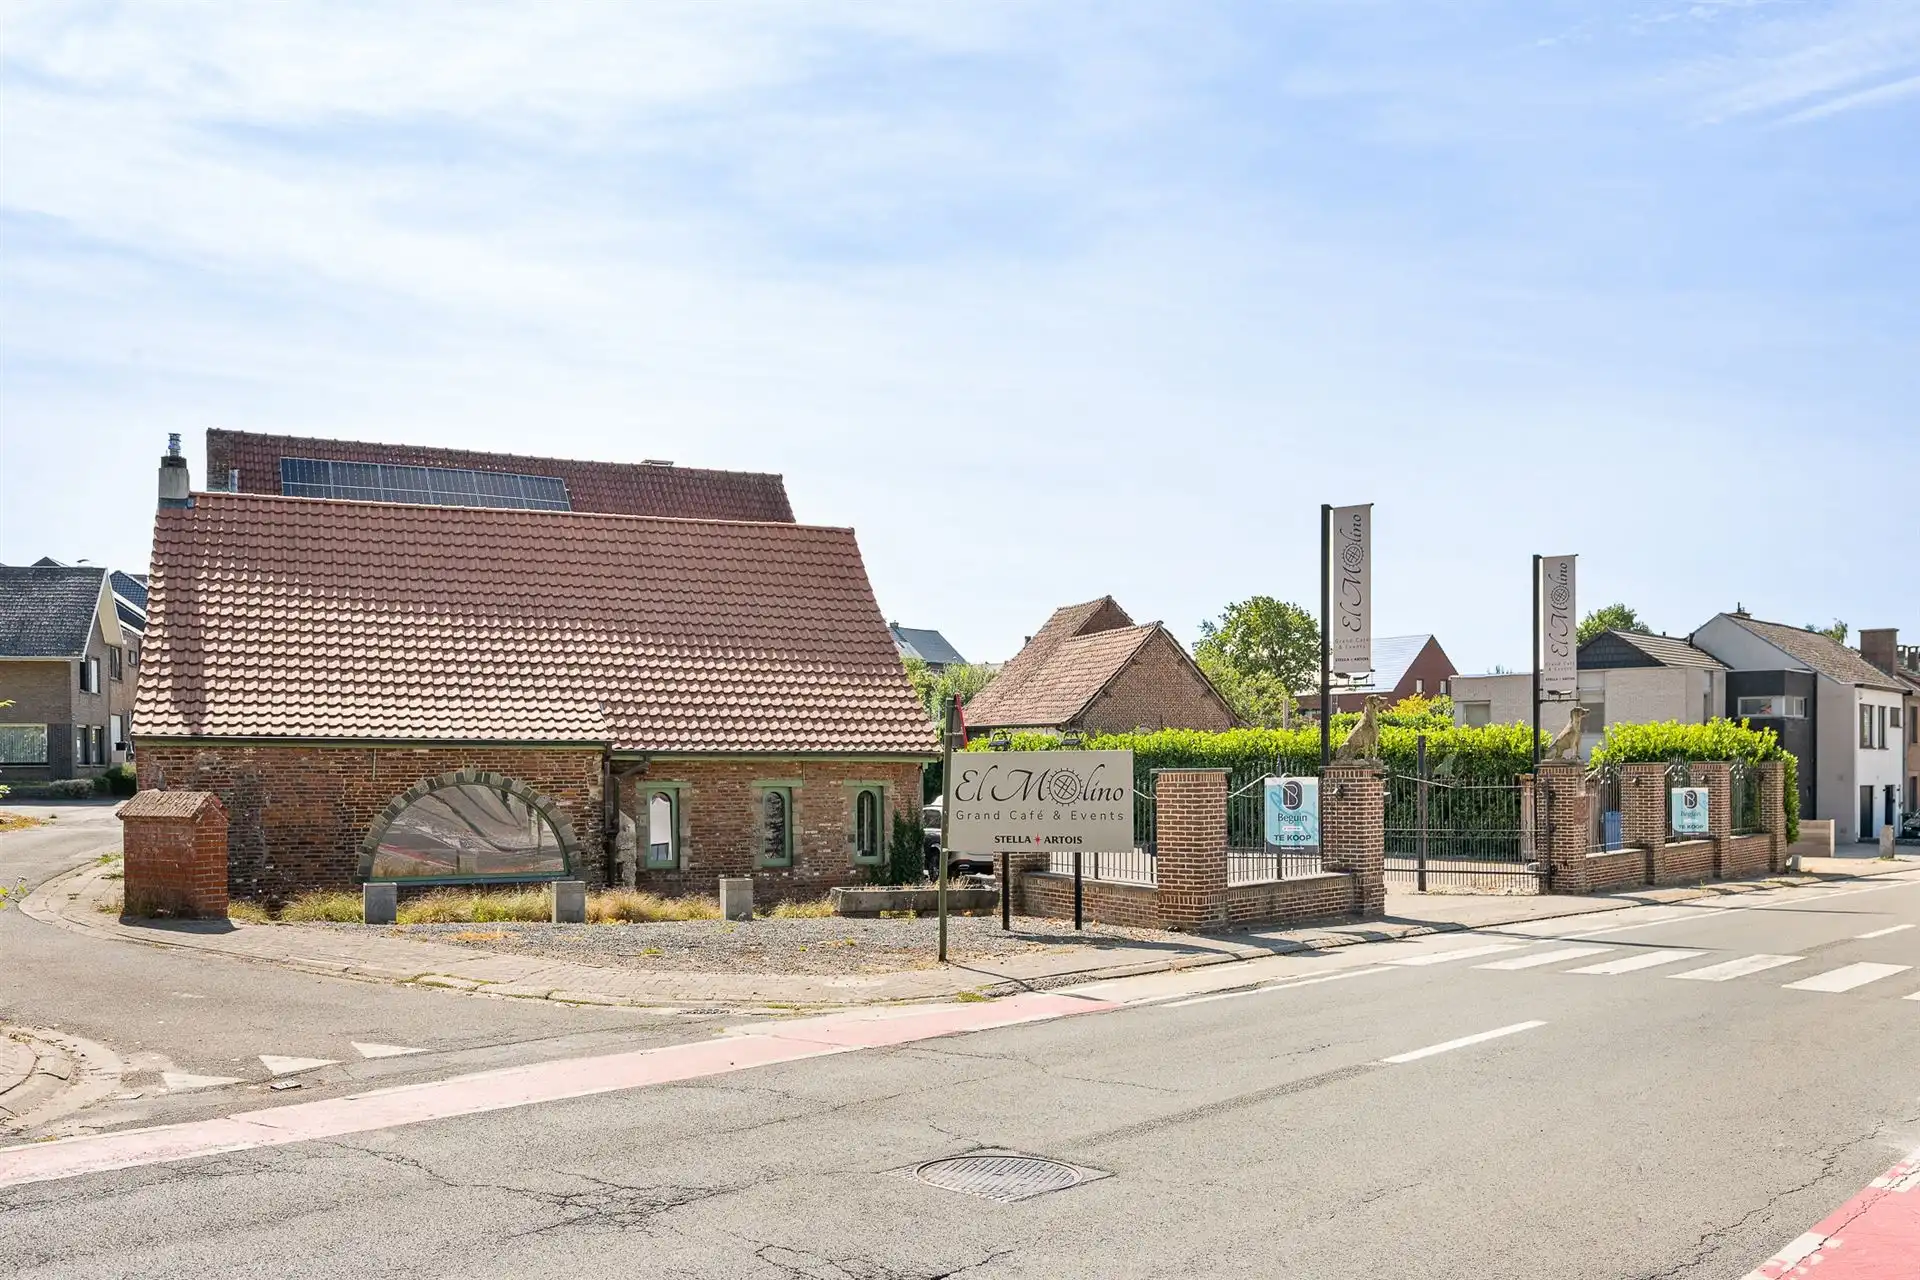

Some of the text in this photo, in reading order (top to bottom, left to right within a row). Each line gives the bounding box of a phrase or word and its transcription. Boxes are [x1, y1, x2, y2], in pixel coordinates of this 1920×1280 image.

[1340, 514, 1364, 632] El Molino
[1548, 562, 1570, 637] Molino
[1549, 633, 1568, 658] El
[955, 763, 1124, 807] El Molino
[956, 810, 1124, 821] Grand Café & Events
[1277, 812, 1308, 824] Beguin
[994, 835, 1083, 845] STELLA ARTOIS
[1274, 834, 1312, 842] TE KOOP
